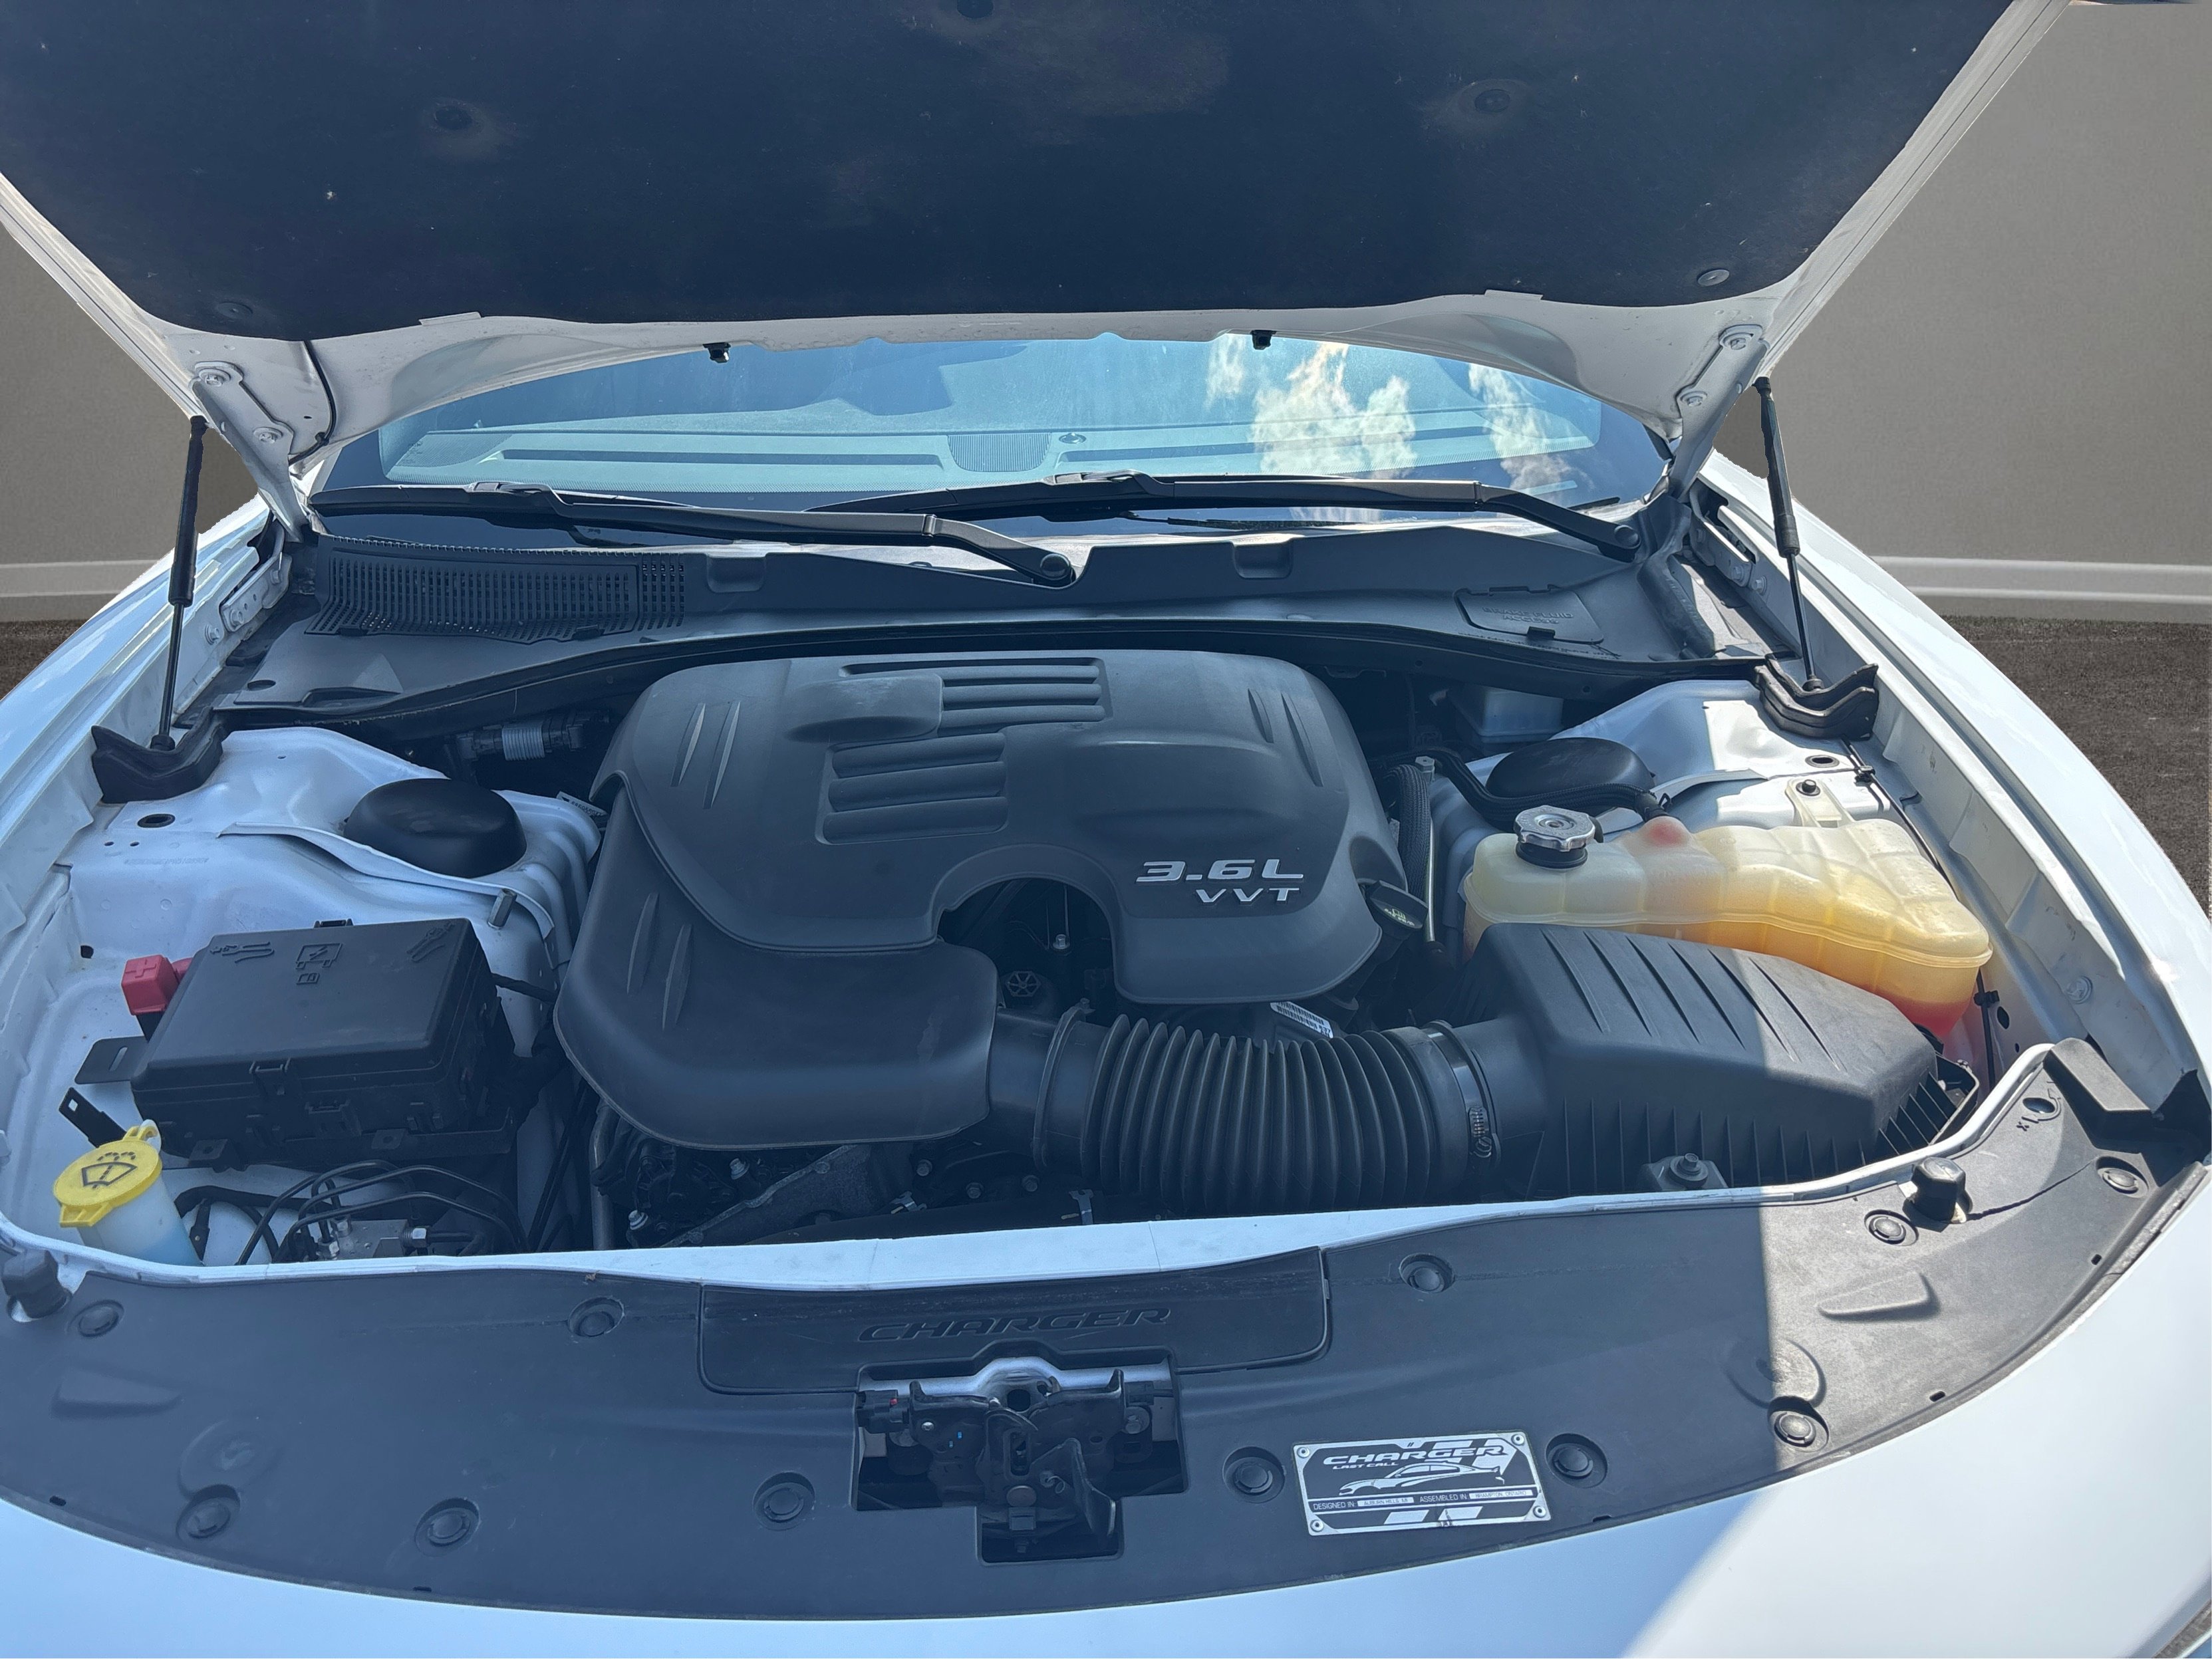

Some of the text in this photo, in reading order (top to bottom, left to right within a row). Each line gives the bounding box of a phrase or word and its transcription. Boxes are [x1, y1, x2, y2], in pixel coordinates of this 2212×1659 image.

[1503, 615, 1559, 624] ACCESS
[1136, 858, 1304, 882] 3.6L
[1196, 888, 1300, 903] VVT
[858, 1307, 1171, 1342] CHARGER
[1323, 1445, 1508, 1465] CHARGER
[1313, 1501, 1346, 1510] DESIGNED
[1419, 1494, 1458, 1503] ASSEMBLED
